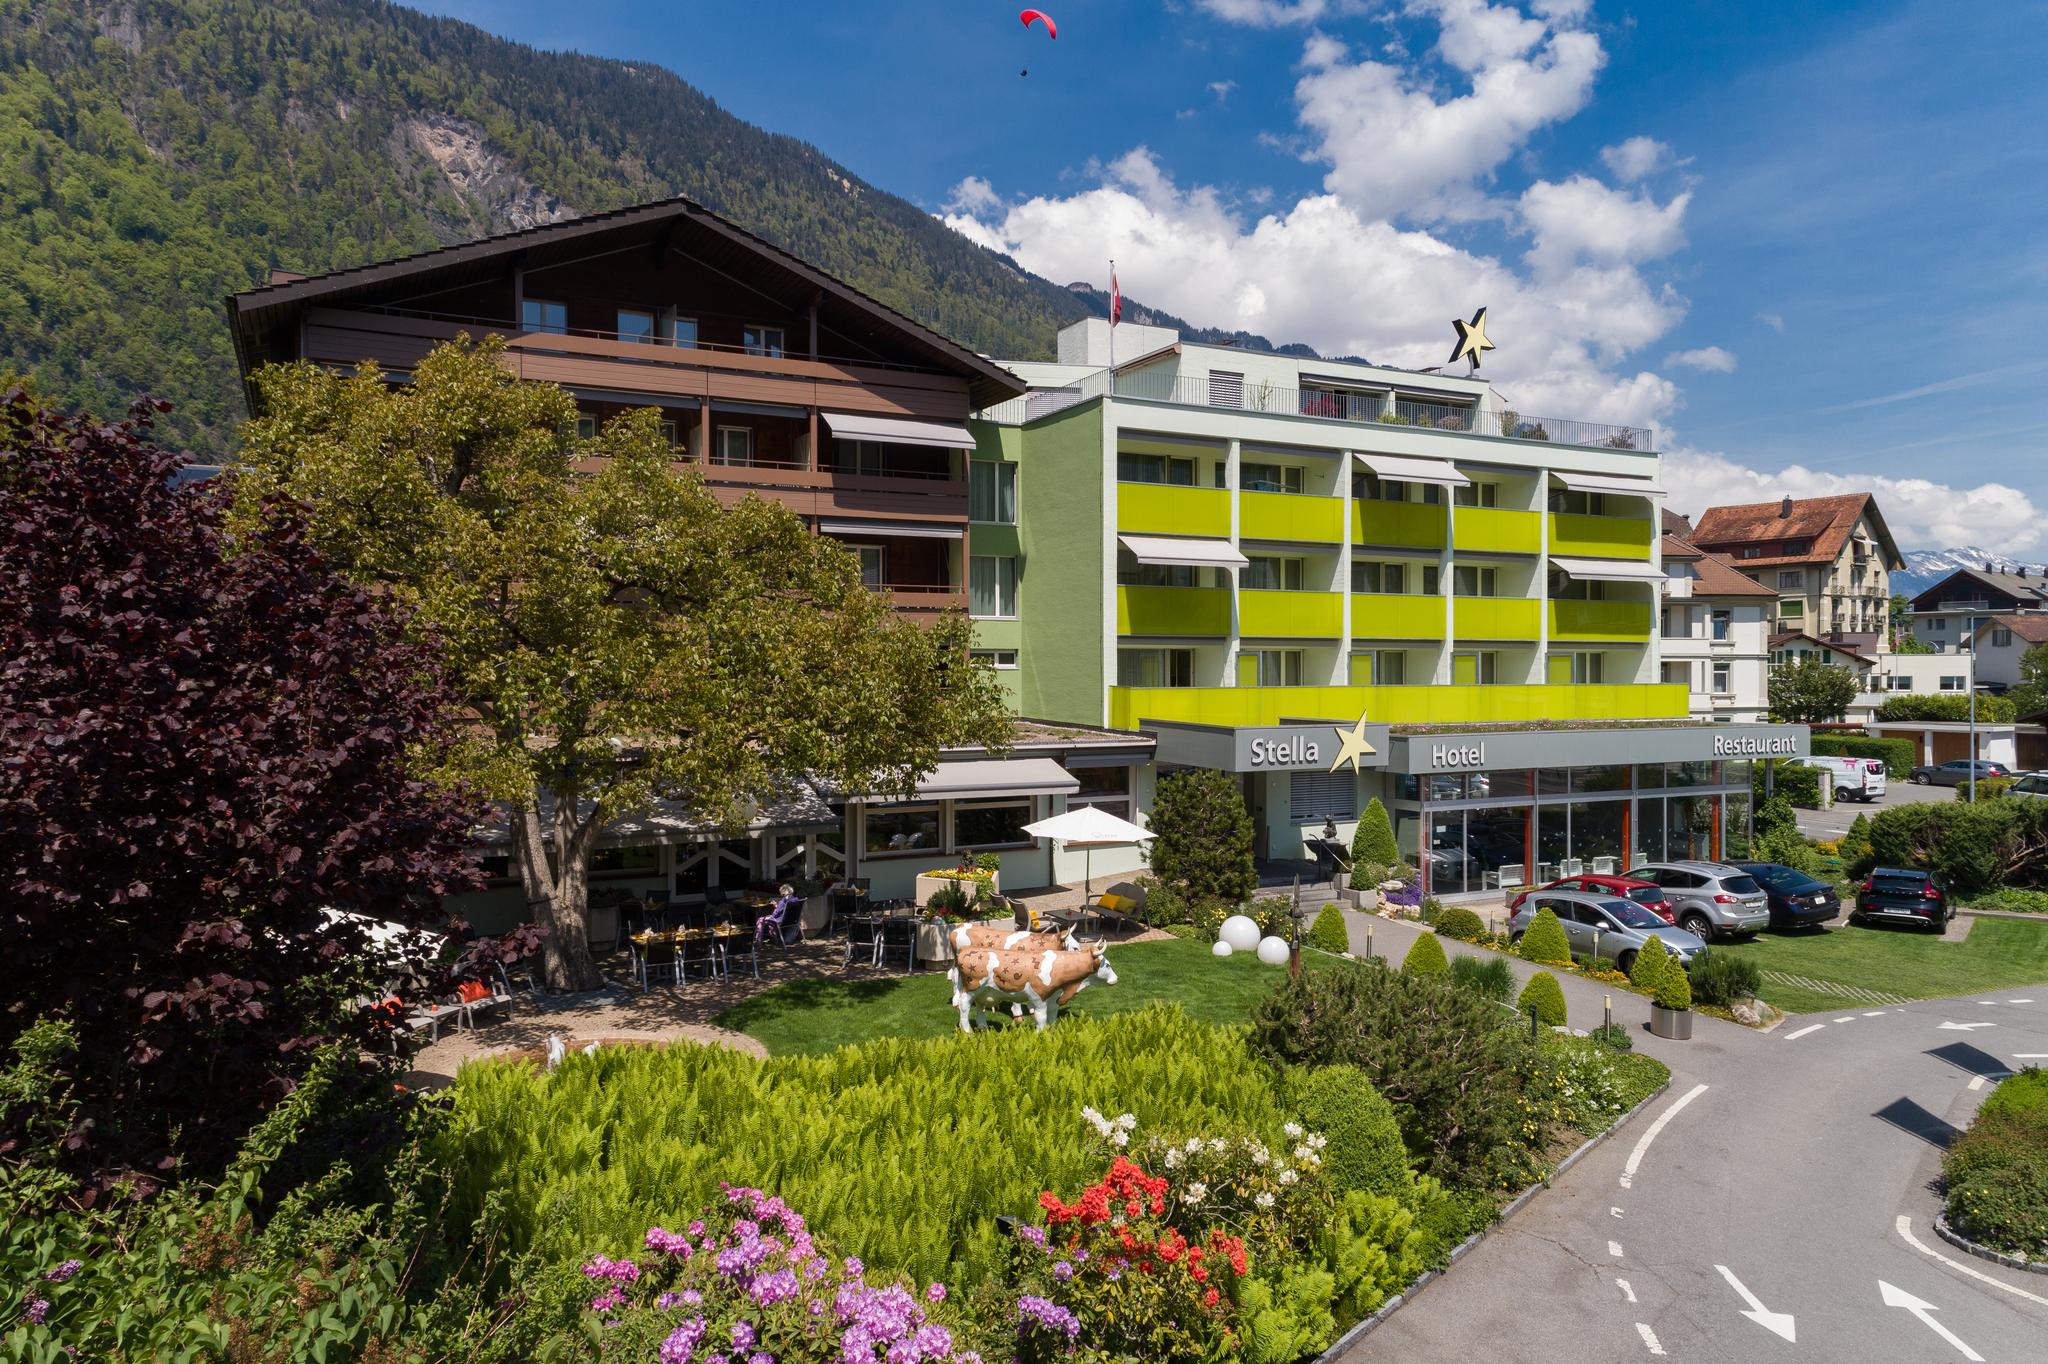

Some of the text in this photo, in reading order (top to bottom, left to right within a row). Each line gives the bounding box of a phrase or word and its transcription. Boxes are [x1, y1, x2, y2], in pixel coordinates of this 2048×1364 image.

[1251, 735, 1319, 764] Stella
[1432, 740, 1485, 767] Hotel
[1713, 735, 1796, 755] Restaurant
